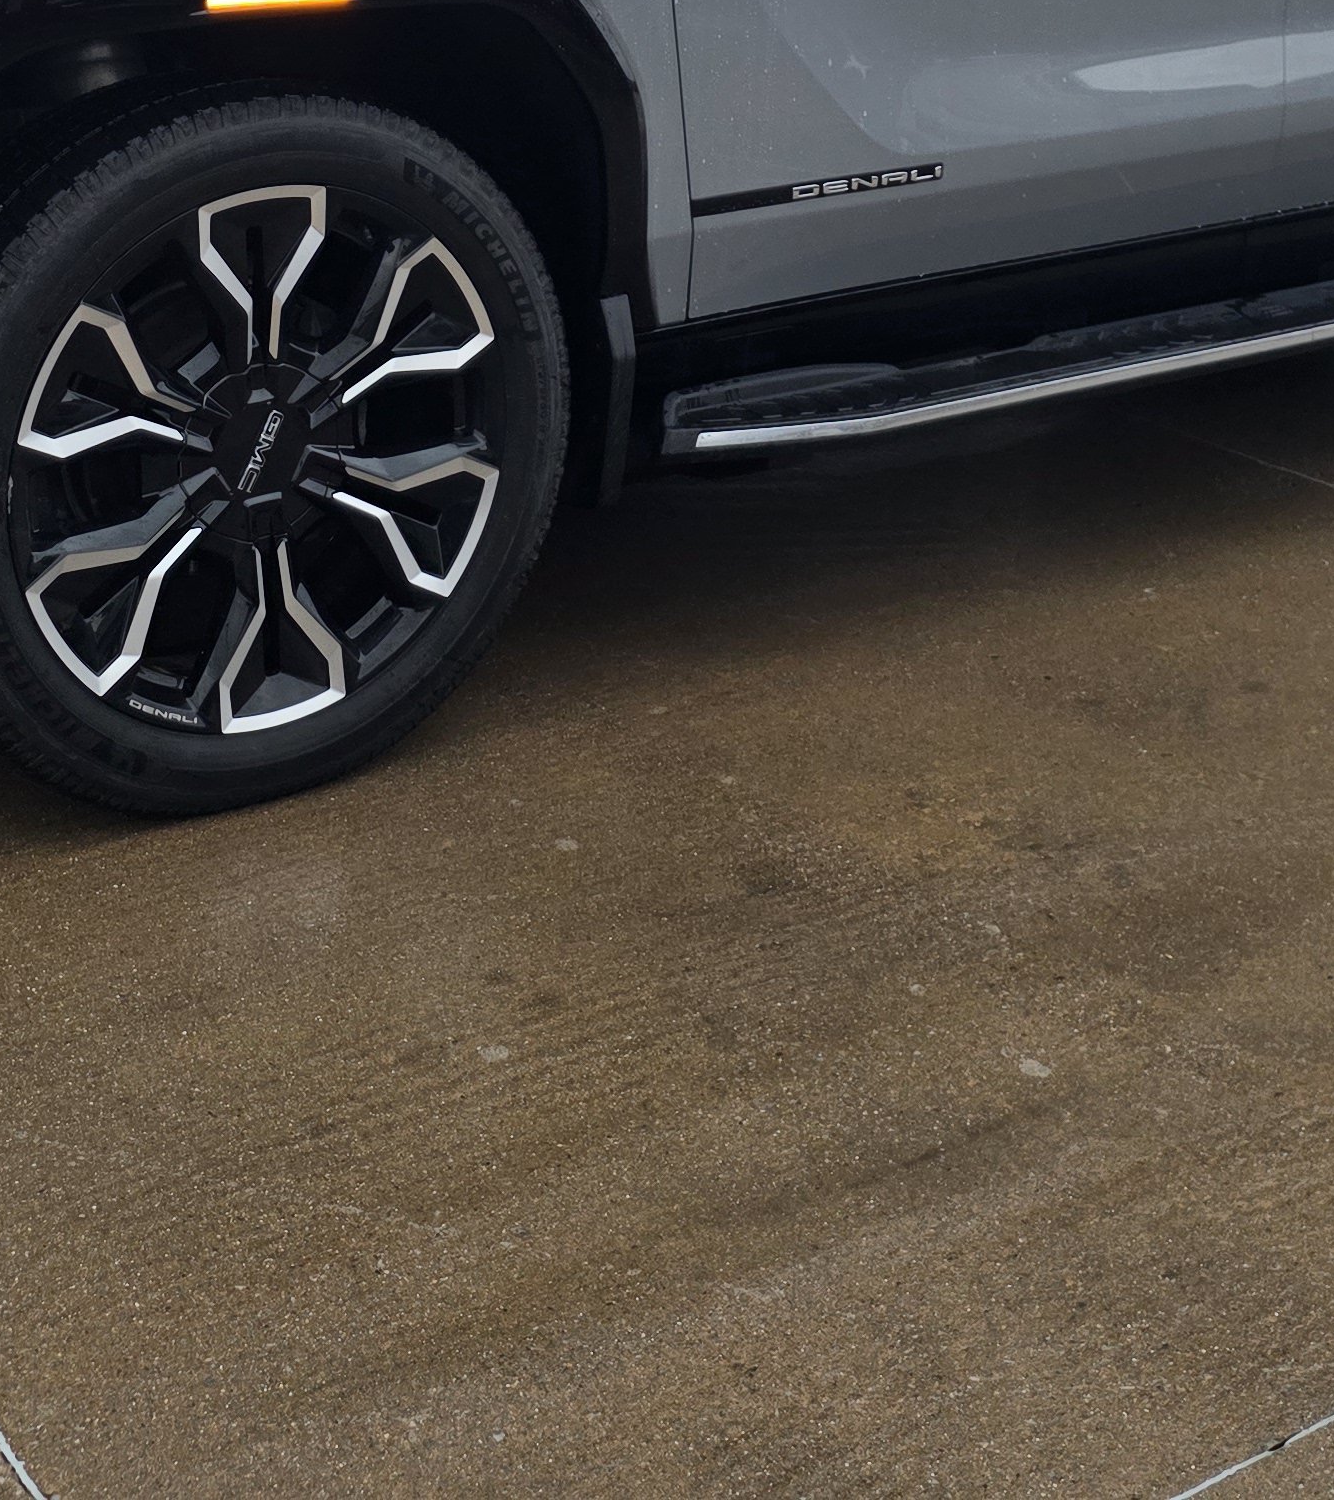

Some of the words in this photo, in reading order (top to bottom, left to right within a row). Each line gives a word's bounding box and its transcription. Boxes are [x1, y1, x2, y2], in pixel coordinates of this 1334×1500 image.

[791, 165, 943, 200] DENALI
[441, 188, 539, 333] MICHELIN
[237, 409, 284, 493] GMC
[128, 699, 198, 724] DENALI
